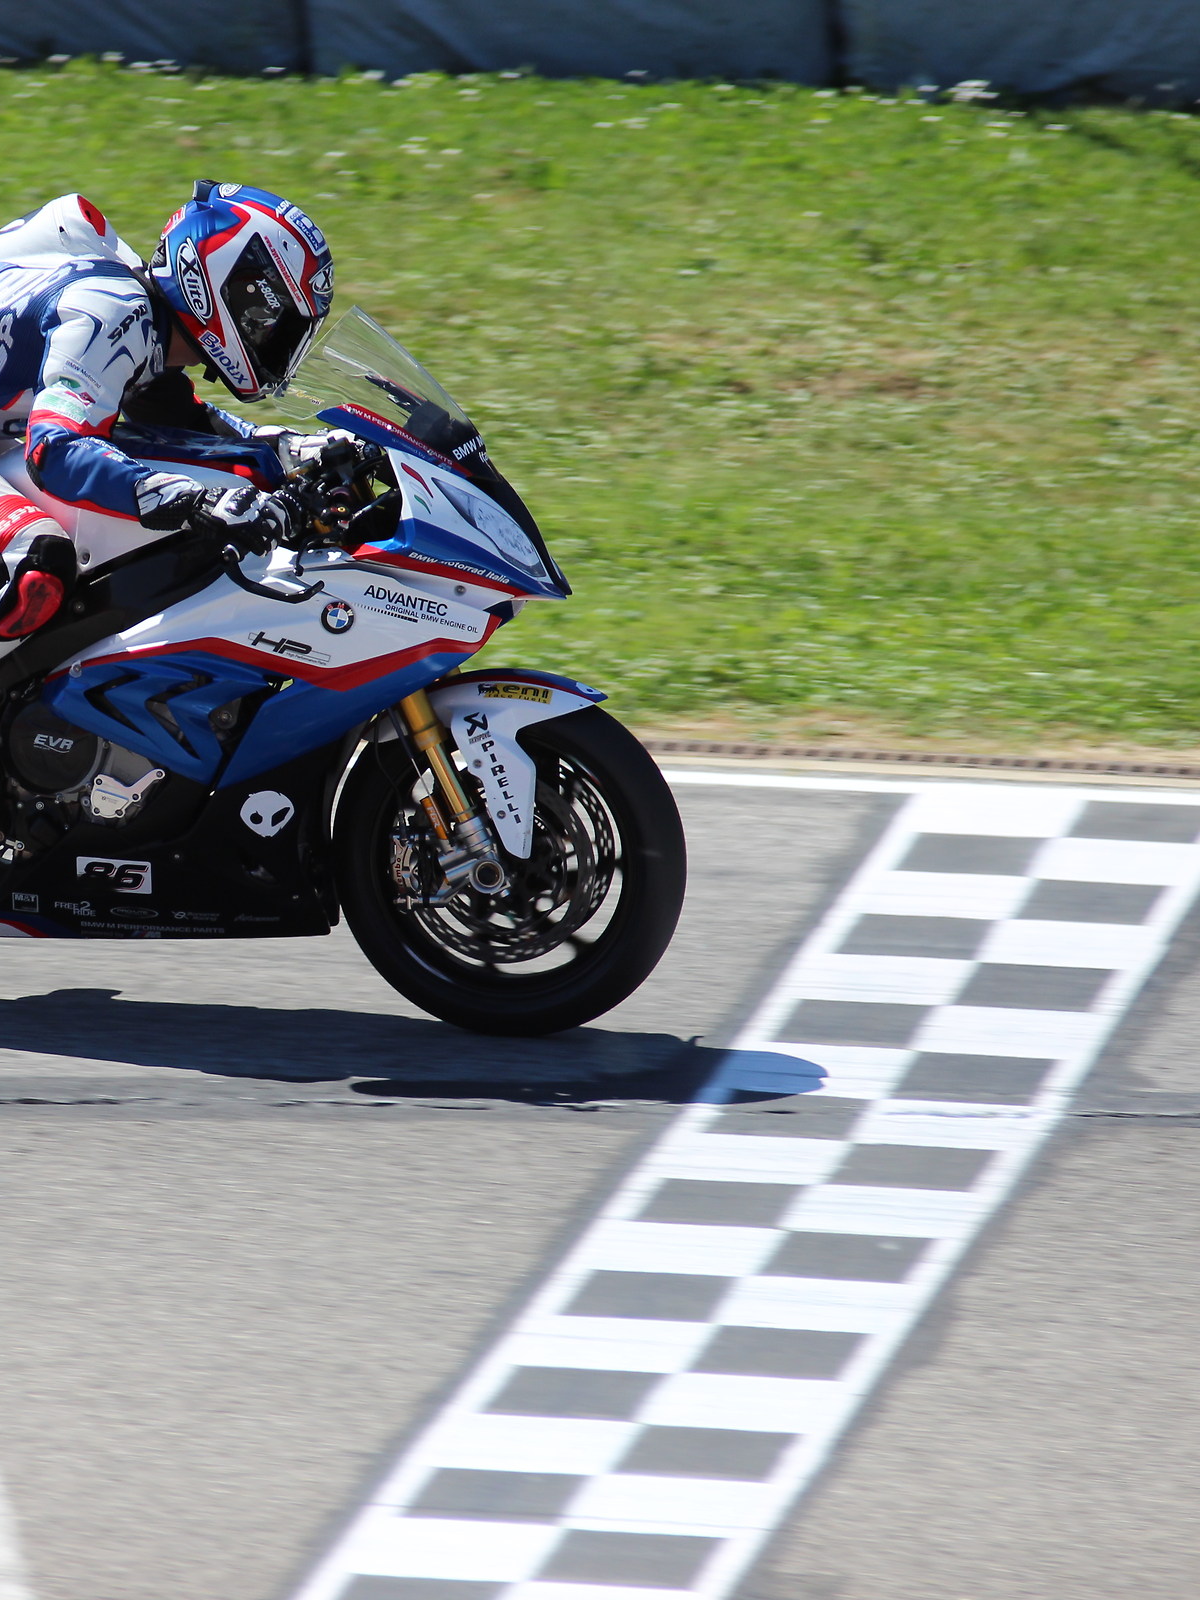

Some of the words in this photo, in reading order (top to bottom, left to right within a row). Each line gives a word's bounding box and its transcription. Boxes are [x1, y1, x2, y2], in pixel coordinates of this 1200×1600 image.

[179, 252, 204, 314] X-lite
[452, 438, 477, 461] BMW
[408, 551, 438, 564] BMW
[485, 568, 510, 585] Italia
[363, 584, 449, 617] ADVANTEC
[385, 604, 419, 618] ORIGINAL
[421, 613, 439, 623] BMW
[440, 618, 466, 631] ENGINE
[467, 625, 478, 634] OIL
[251, 631, 312, 654] HP
[502, 684, 549, 699] eni
[33, 733, 74, 750] EVR
[481, 740, 521, 824] PIRELLI
[54, 900, 80, 910] FREE
[72, 908, 97, 917] RIDE
[79, 899, 91, 910] 2
[80, 920, 105, 928] BMW
[192, 926, 225, 934] PARTS
